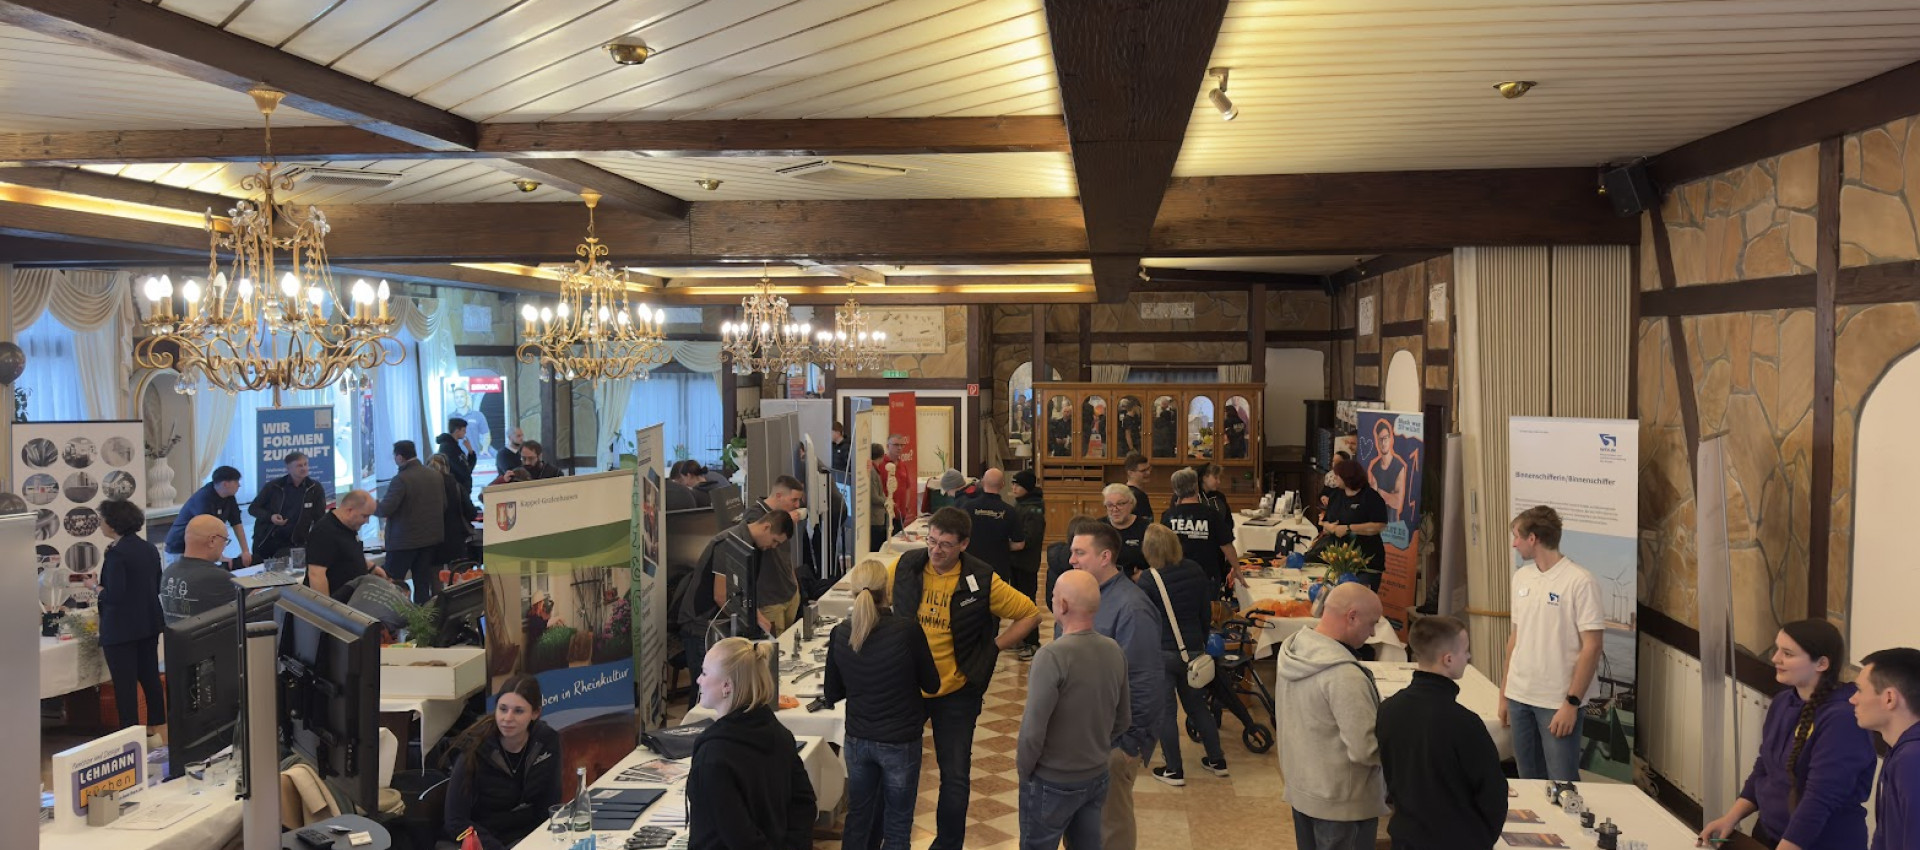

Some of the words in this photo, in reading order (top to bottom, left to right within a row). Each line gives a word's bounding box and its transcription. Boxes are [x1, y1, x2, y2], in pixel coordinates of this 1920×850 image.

[262, 422, 290, 434] WIR
[263, 433, 324, 448] FORMEN
[1170, 519, 1209, 531] TEAM
[541, 694, 559, 706] ben
[561, 689, 571, 699] in
[573, 668, 630, 696] Rheinkultur
[80, 752, 135, 785] LEHMANN
